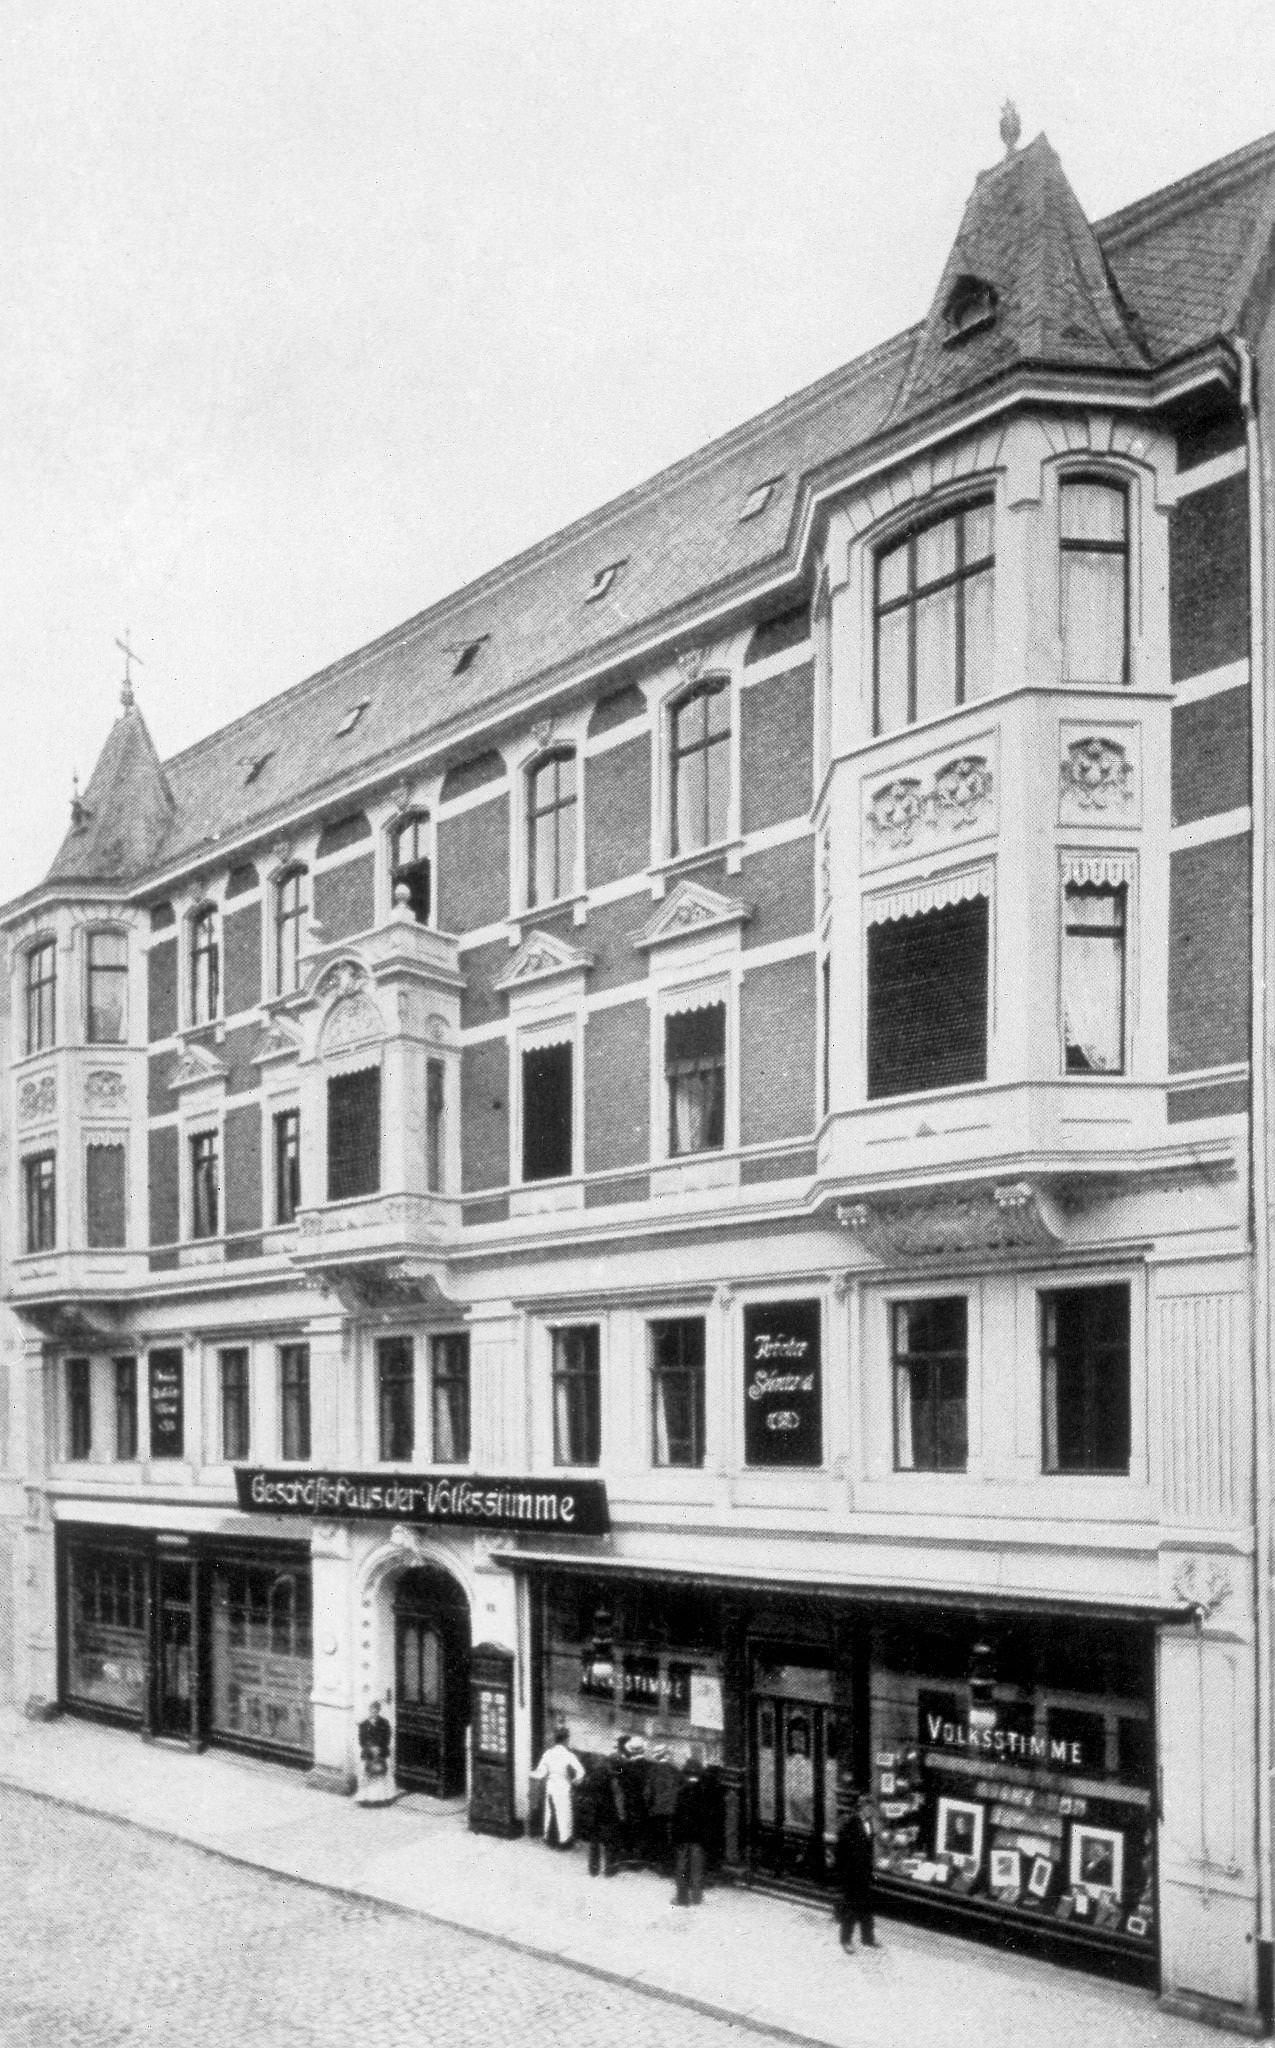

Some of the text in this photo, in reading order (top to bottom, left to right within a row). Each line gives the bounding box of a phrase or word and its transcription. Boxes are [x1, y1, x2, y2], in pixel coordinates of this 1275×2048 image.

[385, 1480, 422, 1511] der
[423, 1479, 576, 1522] Volksstimme
[926, 1712, 1082, 1764] VOLKSSTIMME
